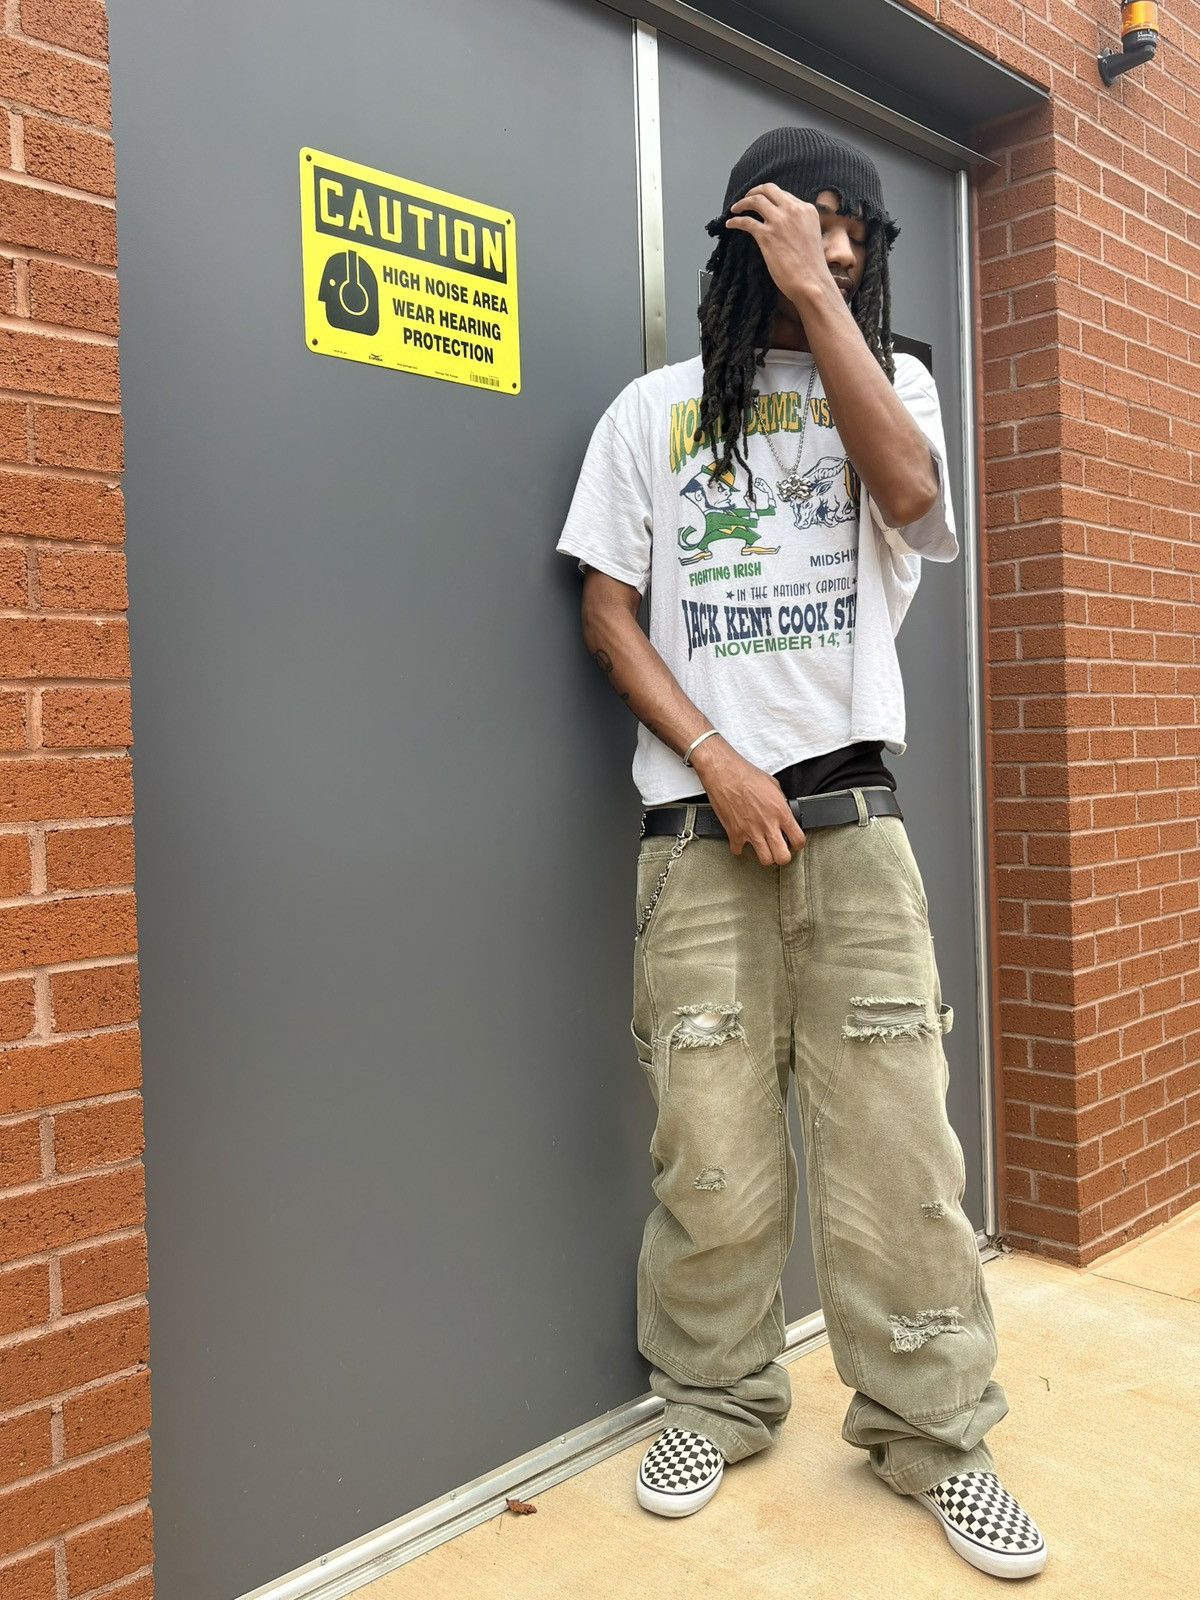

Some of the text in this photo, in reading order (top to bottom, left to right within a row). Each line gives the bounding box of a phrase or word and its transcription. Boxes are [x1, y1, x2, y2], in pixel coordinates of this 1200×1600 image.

[319, 177, 504, 273] CAUTION
[383, 265, 508, 315] HIGH NOISE AREA
[392, 297, 501, 341] WEAR HEARING
[403, 327, 494, 364] PROTECTION
[688, 562, 762, 587] FIGHTING IRISH
[810, 548, 858, 568] MIDSHI
[737, 577, 851, 602] IN THE NATION'S CAPITOL
[681, 592, 857, 662] JACK KENT COOK ST
[714, 635, 812, 658] NOVEMBER
